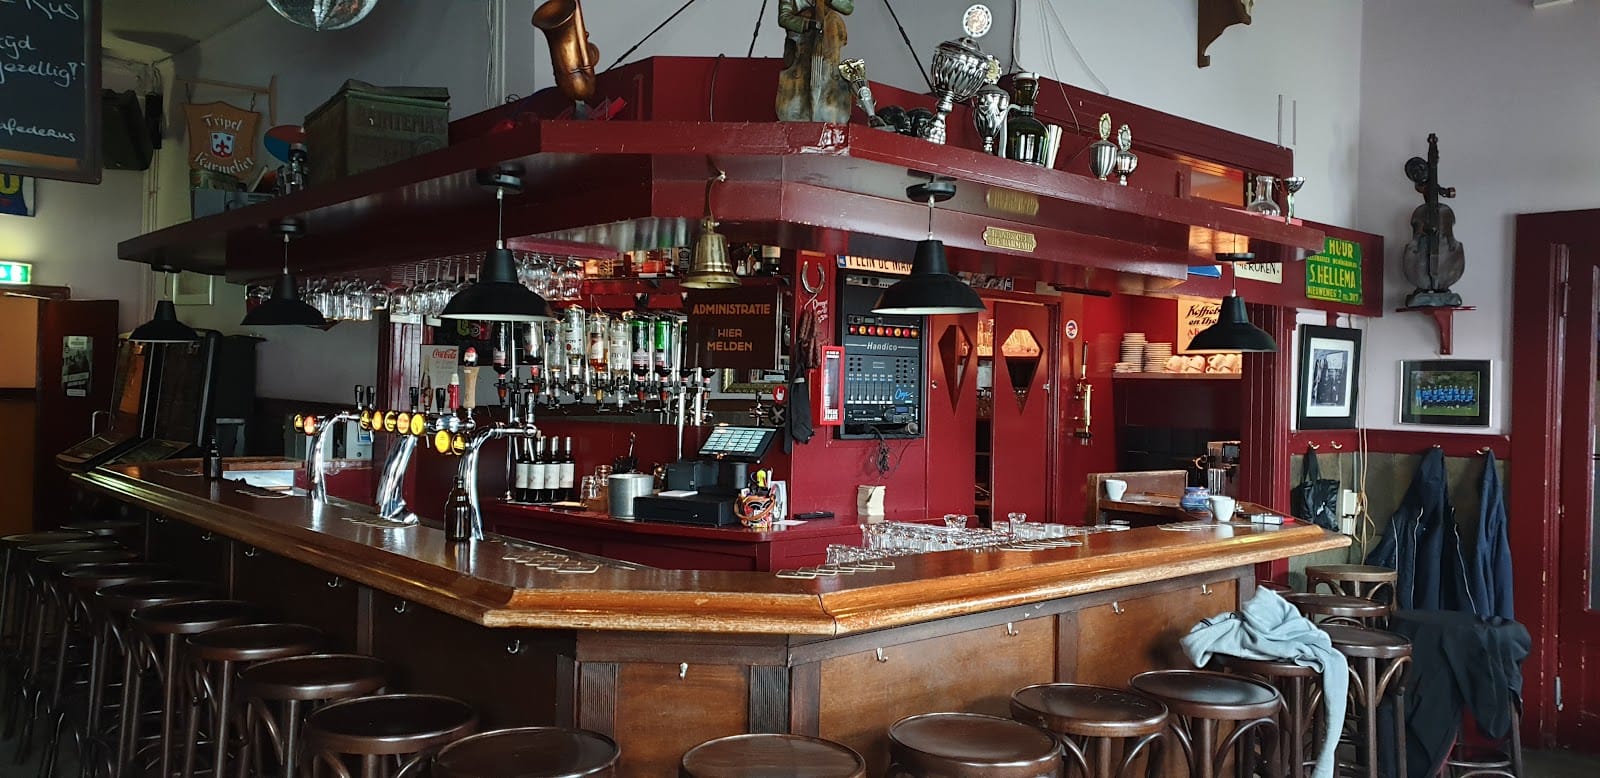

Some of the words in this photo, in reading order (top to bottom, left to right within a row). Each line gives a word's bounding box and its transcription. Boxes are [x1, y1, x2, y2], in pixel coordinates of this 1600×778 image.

[200, 113, 243, 131] Tripel
[194, 152, 254, 174] Karmeliet
[1329, 239, 1353, 259] HUUR
[692, 303, 771, 315] ADMINISTRATIE
[718, 328, 743, 338] HIER
[707, 341, 753, 351] MELDEN
[867, 341, 898, 351] Handico
